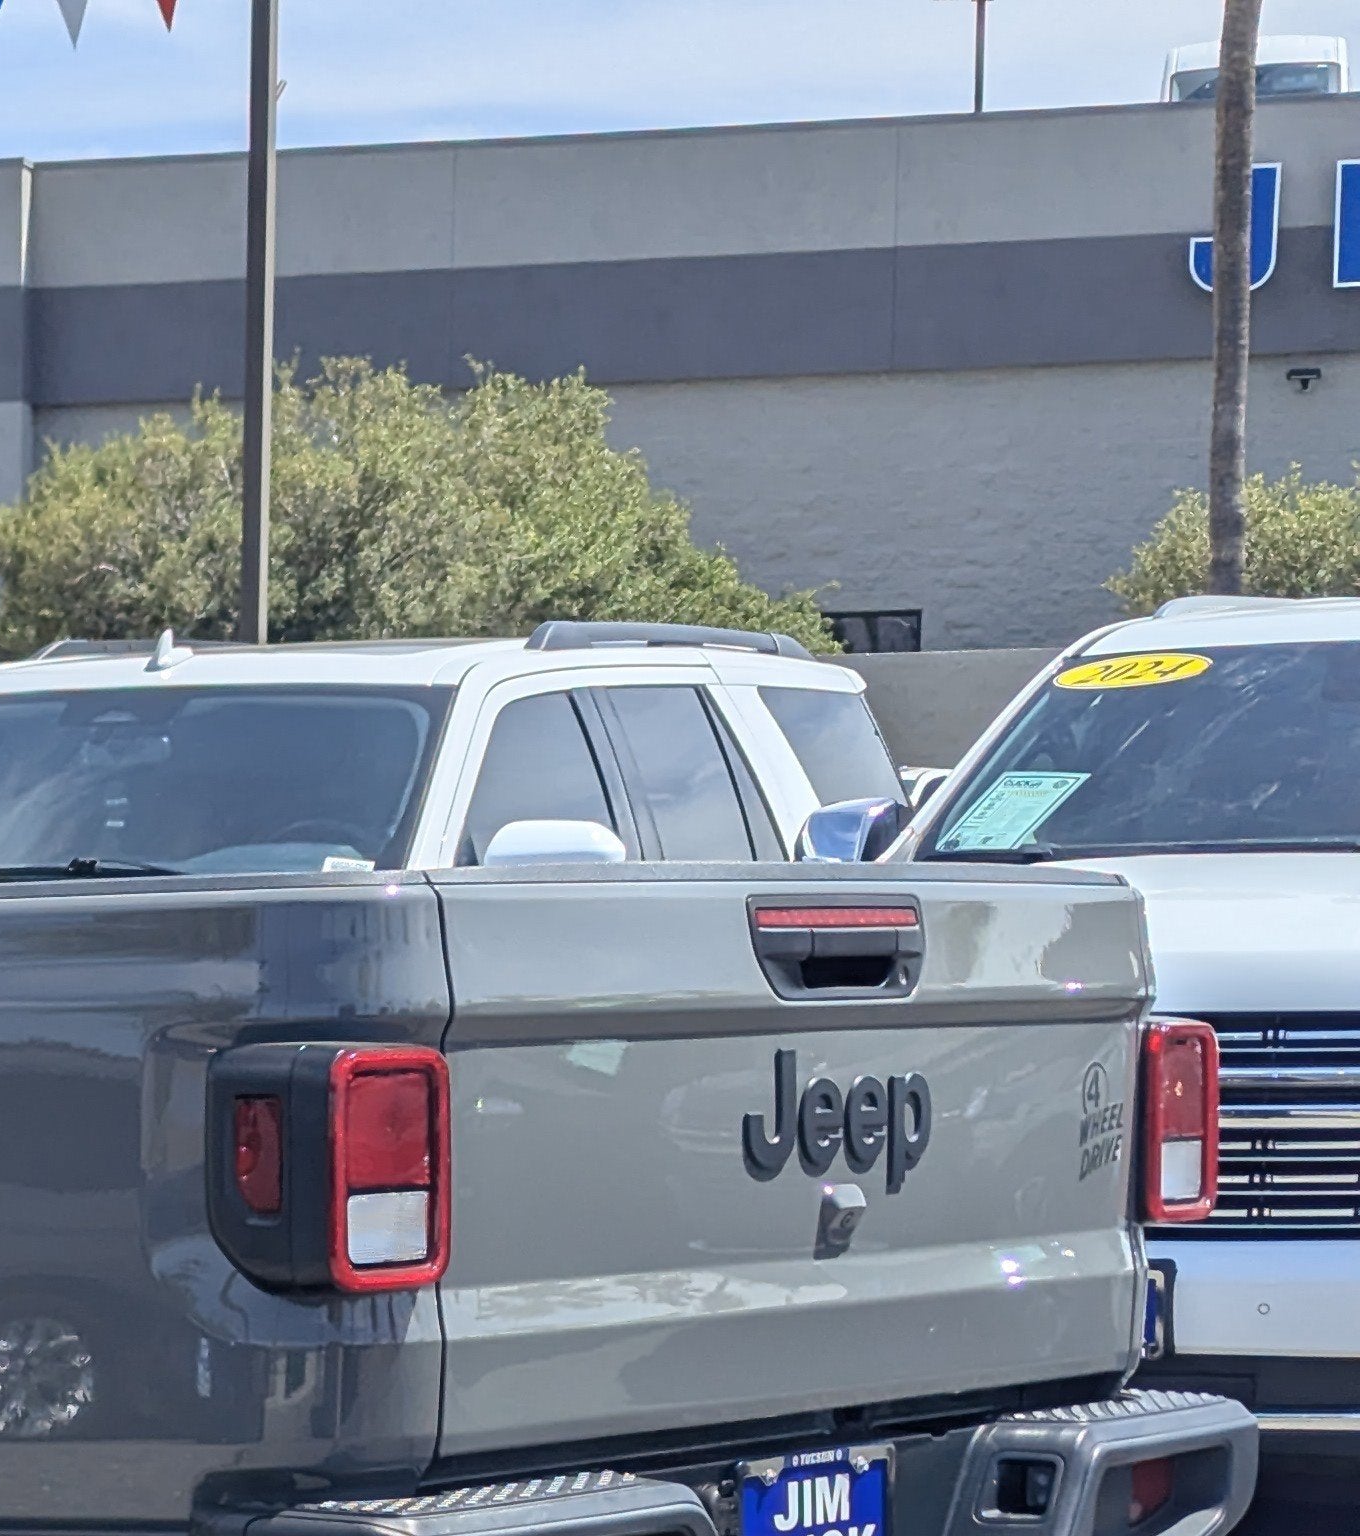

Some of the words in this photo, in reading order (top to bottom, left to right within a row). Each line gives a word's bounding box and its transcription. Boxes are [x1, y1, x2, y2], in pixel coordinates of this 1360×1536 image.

[1070, 659, 1195, 685] 2024
[1086, 1069, 1100, 1108] 4
[742, 1048, 932, 1194] Jeep
[1079, 1102, 1123, 1147] WHEEL
[1079, 1134, 1123, 1182] DRIVE
[773, 1473, 851, 1532] JIM
